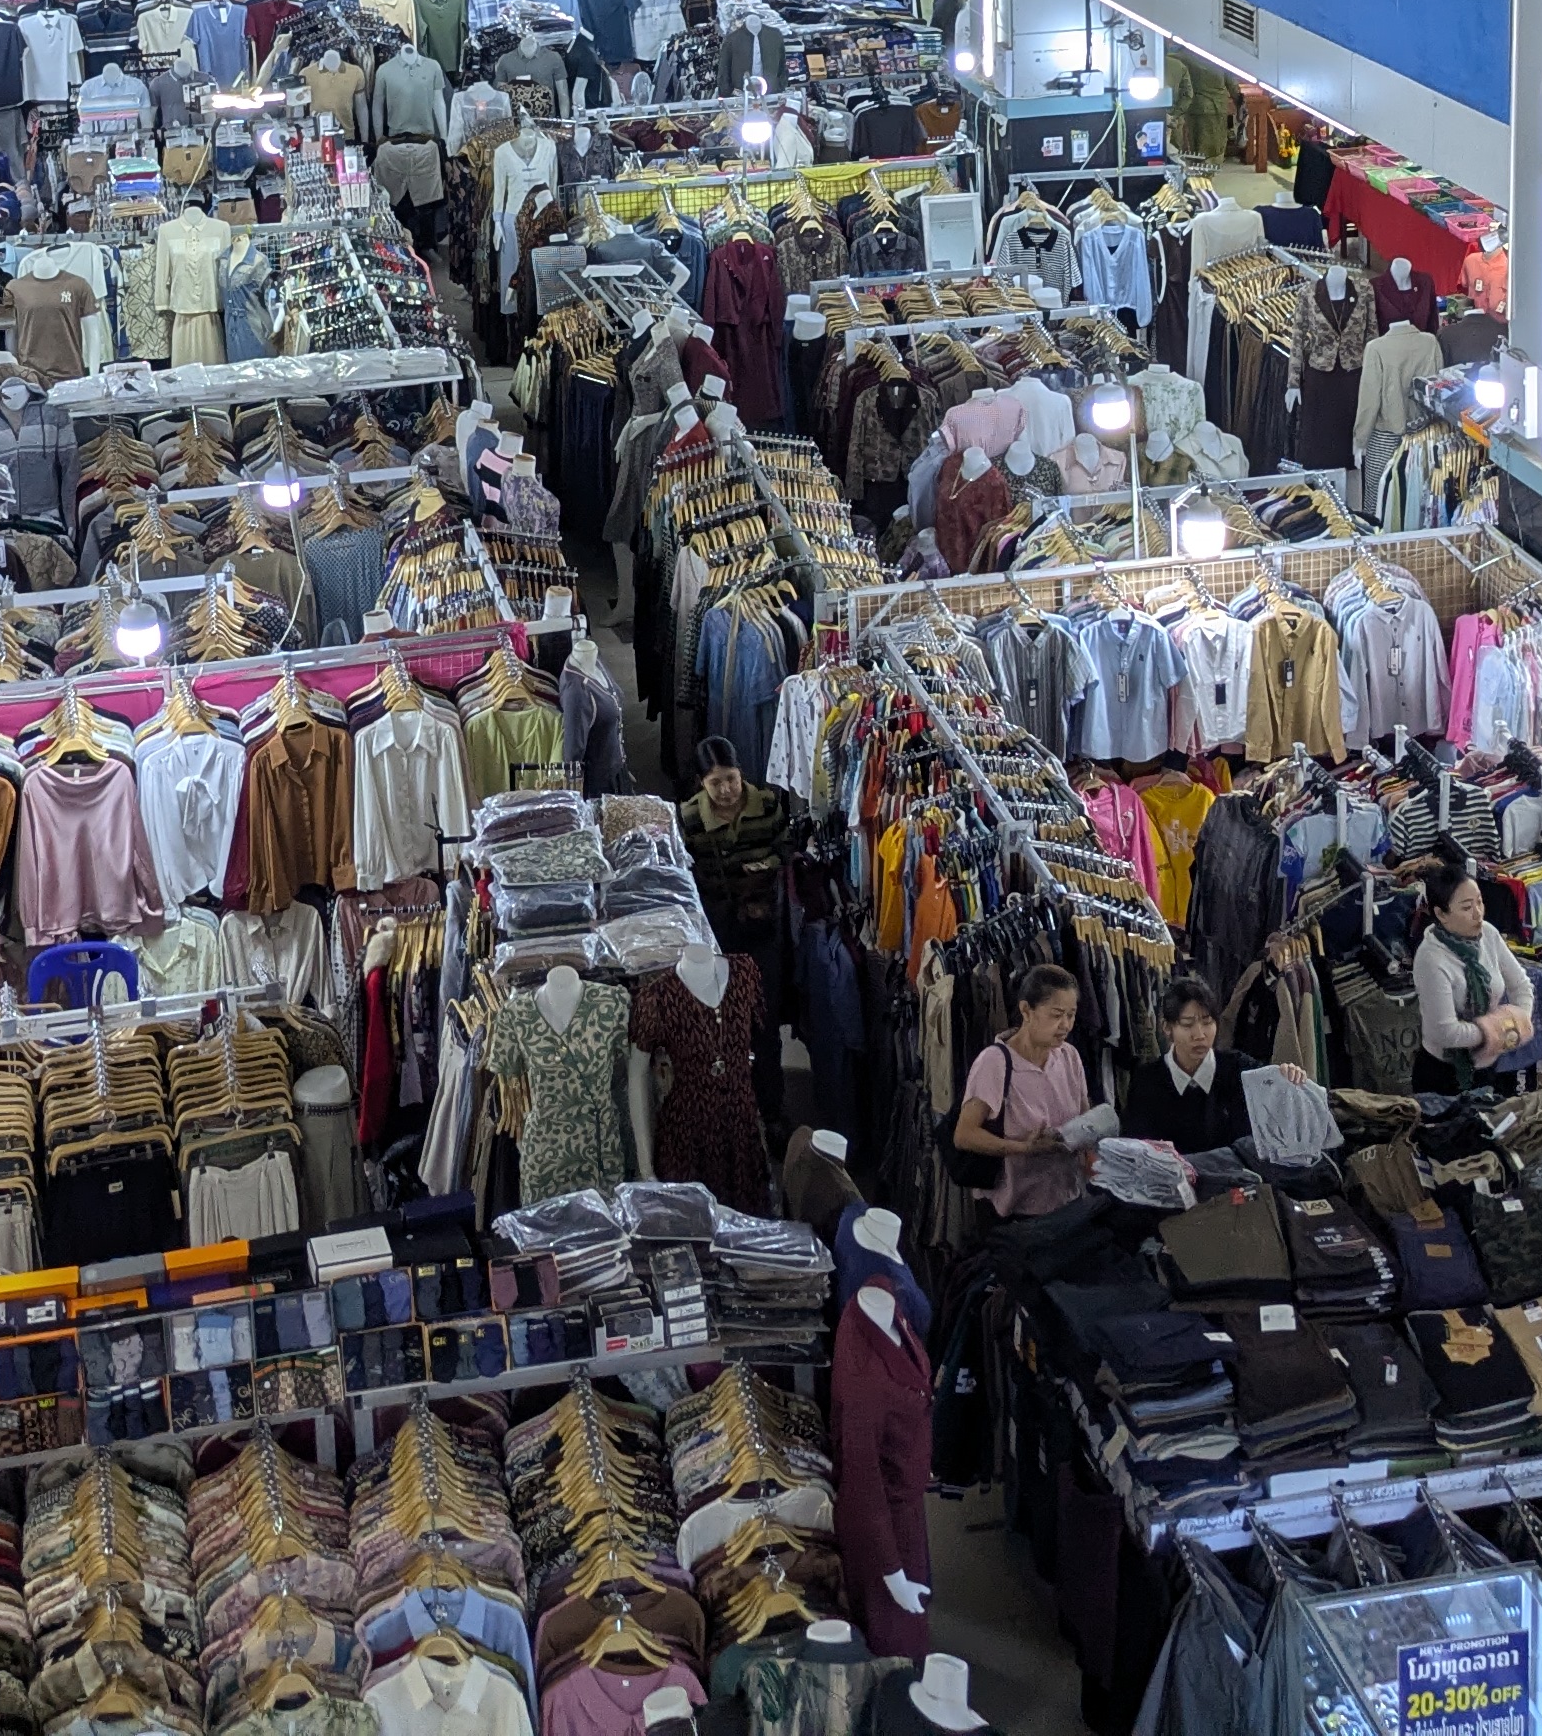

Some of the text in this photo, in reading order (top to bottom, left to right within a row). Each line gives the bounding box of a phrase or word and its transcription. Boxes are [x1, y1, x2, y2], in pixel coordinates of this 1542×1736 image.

[1419, 1634, 1510, 1657] NEW PROMOTION
[1407, 1682, 1523, 1720] 20-30% OFF
